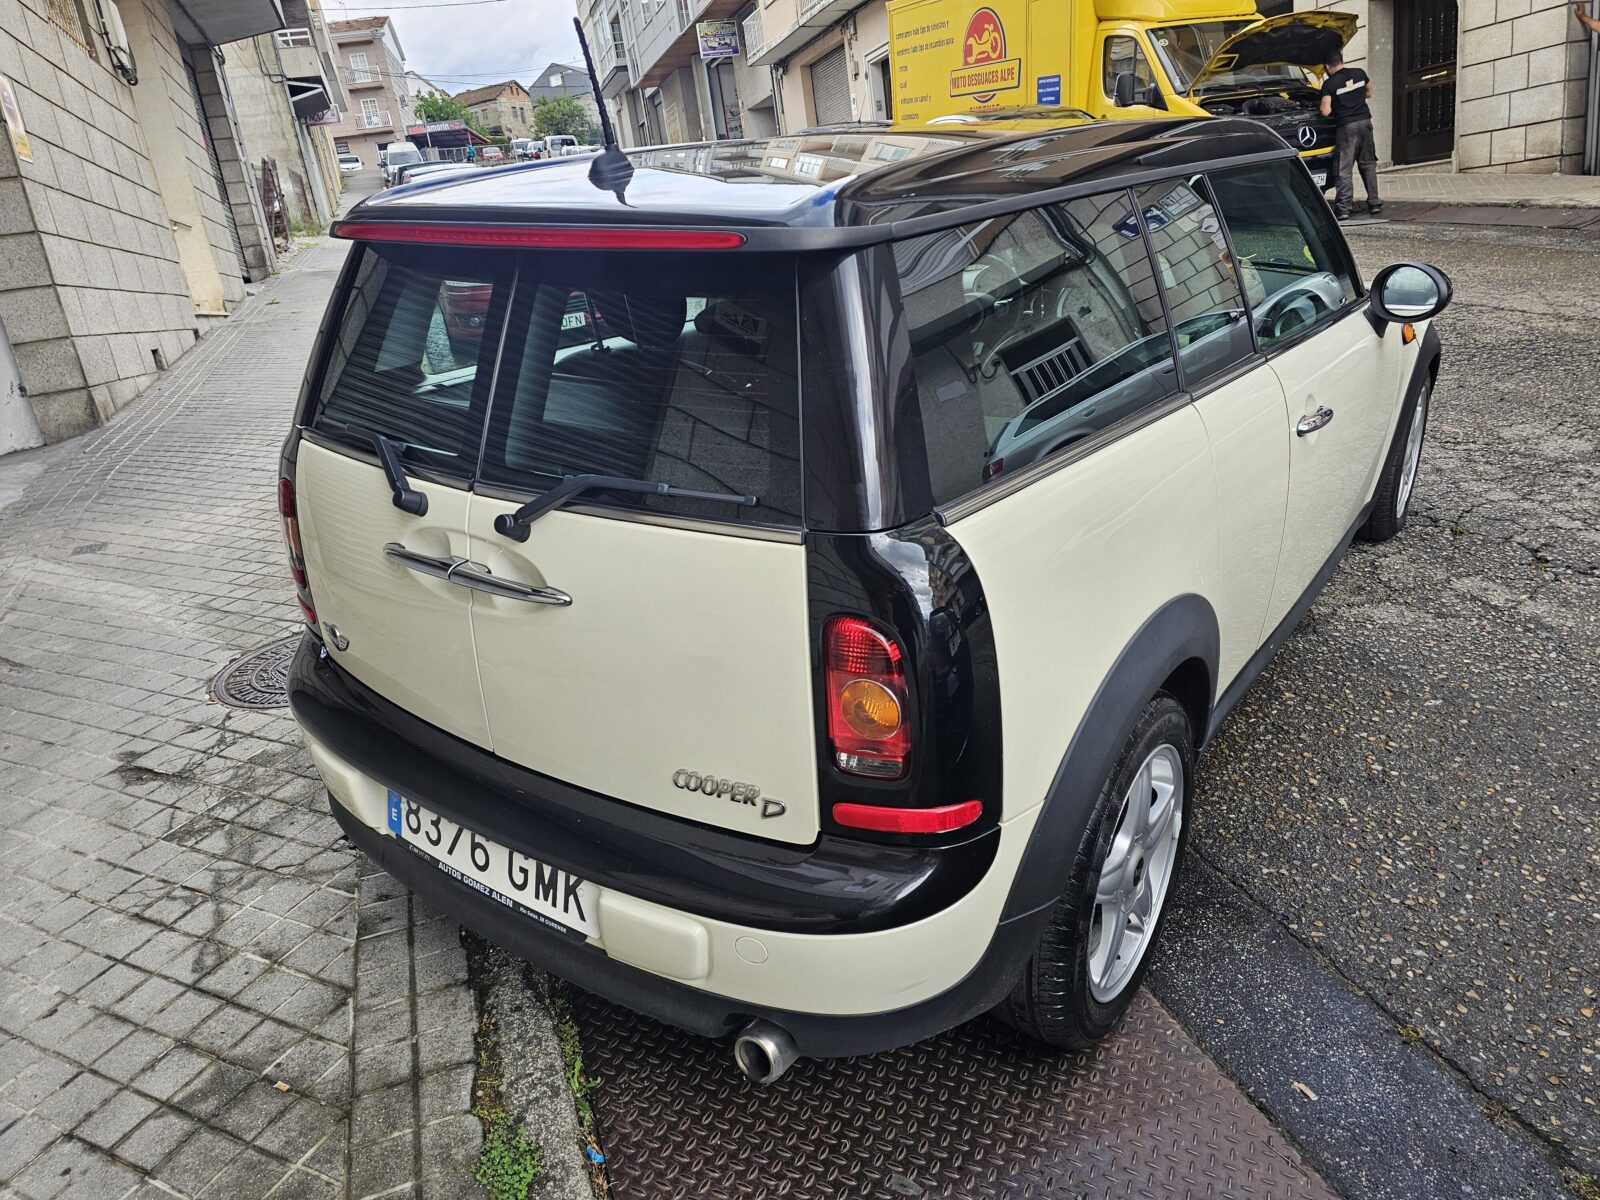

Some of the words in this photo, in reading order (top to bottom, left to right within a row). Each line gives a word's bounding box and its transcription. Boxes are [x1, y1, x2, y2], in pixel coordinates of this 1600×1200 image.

[952, 76, 966, 89] MOTO
[967, 70, 999, 87] DESGUACES
[1000, 67, 1015, 82] ALPE
[392, 807, 398, 822] E
[672, 768, 760, 807] COOPER
[760, 797, 787, 819] D
[405, 799, 490, 873] 8376
[508, 849, 587, 923] GMK
[438, 861, 462, 880] AUTOS
[463, 875, 490, 896] GOMEZ
[491, 890, 513, 908] ALEN
